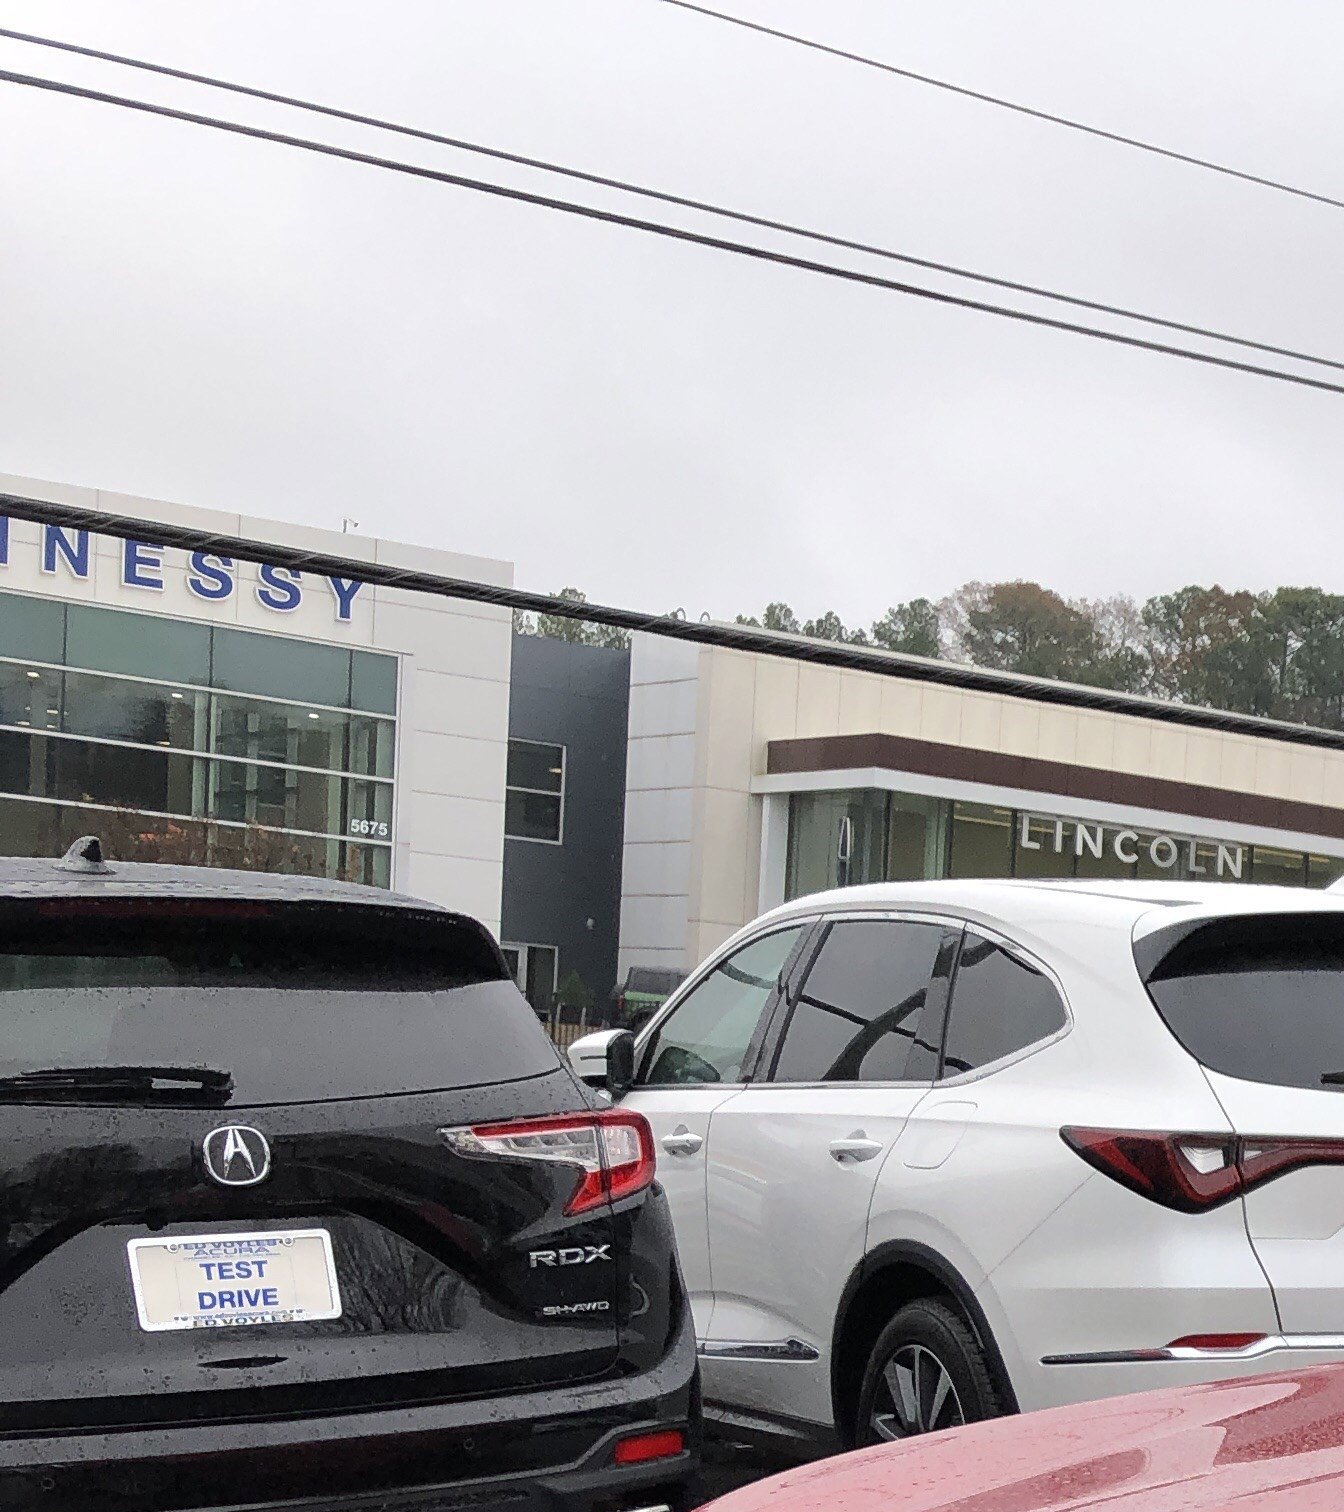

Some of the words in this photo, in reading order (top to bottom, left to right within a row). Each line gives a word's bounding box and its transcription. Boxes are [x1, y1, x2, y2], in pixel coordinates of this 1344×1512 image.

[0, 515, 365, 622] NESSY
[350, 818, 388, 836] 5675
[1020, 812, 1243, 879] LINCOLN
[194, 1246, 271, 1257] ACURA
[529, 1244, 612, 1268] RDX
[199, 1259, 268, 1281] TEST
[198, 1287, 280, 1310] DRIVE
[542, 1300, 610, 1316] SH-AWD
